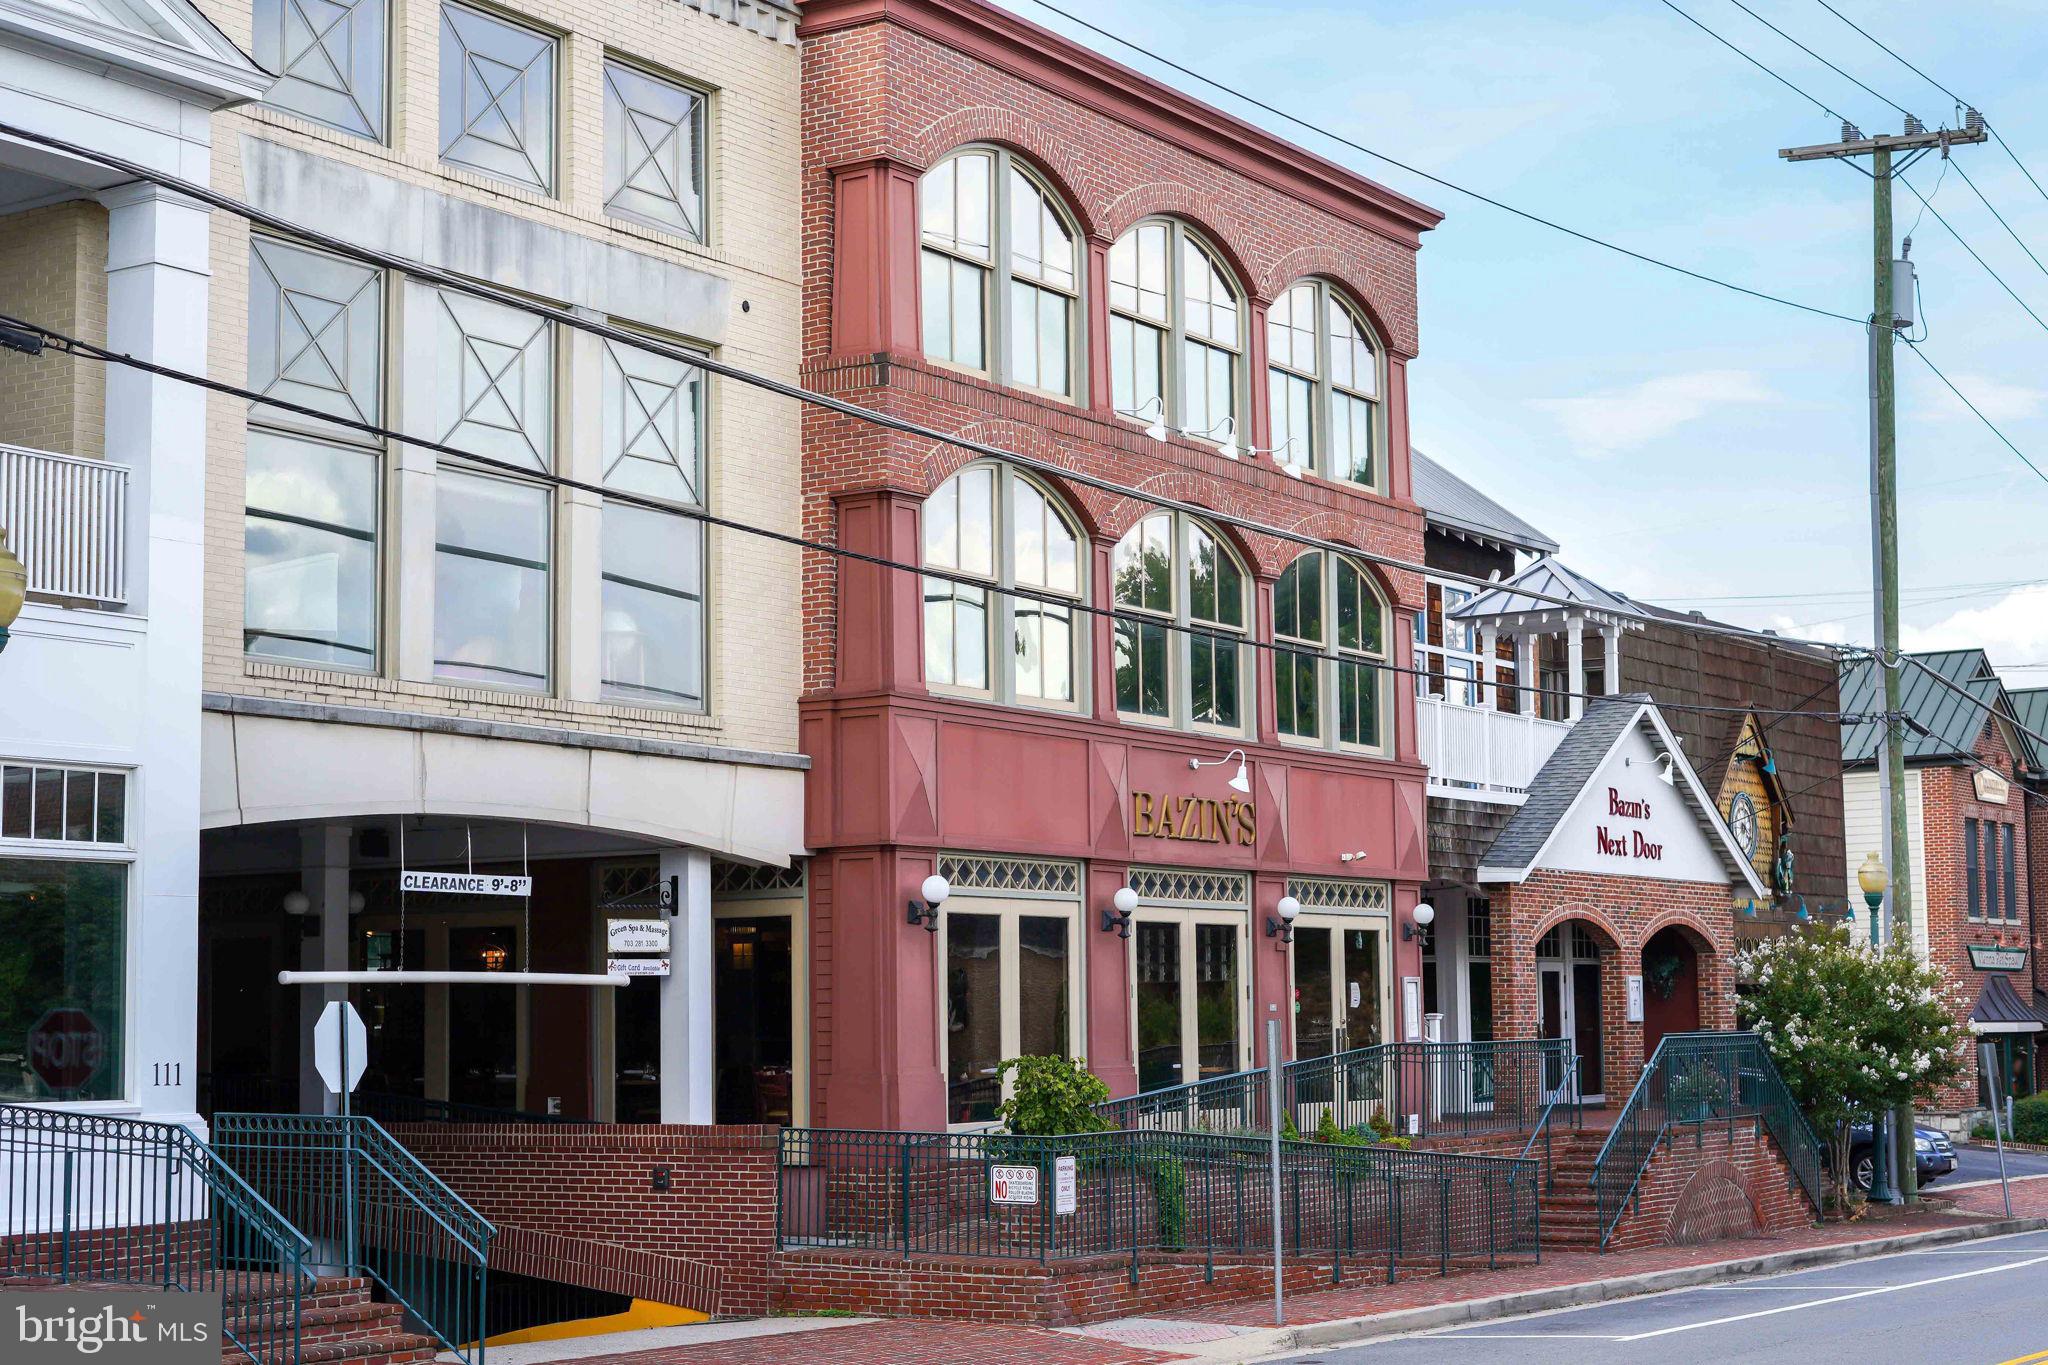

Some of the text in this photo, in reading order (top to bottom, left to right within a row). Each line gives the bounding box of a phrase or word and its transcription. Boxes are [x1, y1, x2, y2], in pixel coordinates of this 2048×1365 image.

[1608, 787, 1650, 820] Bazin's
[1132, 789, 1256, 846] BAZIN'S
[1596, 825, 1663, 860] Next Door
[403, 875, 485, 892] CLEARANCE
[610, 923, 668, 937] Green Spa & Massage
[152, 1062, 182, 1087] 111
[995, 1180, 1008, 1199] NO
